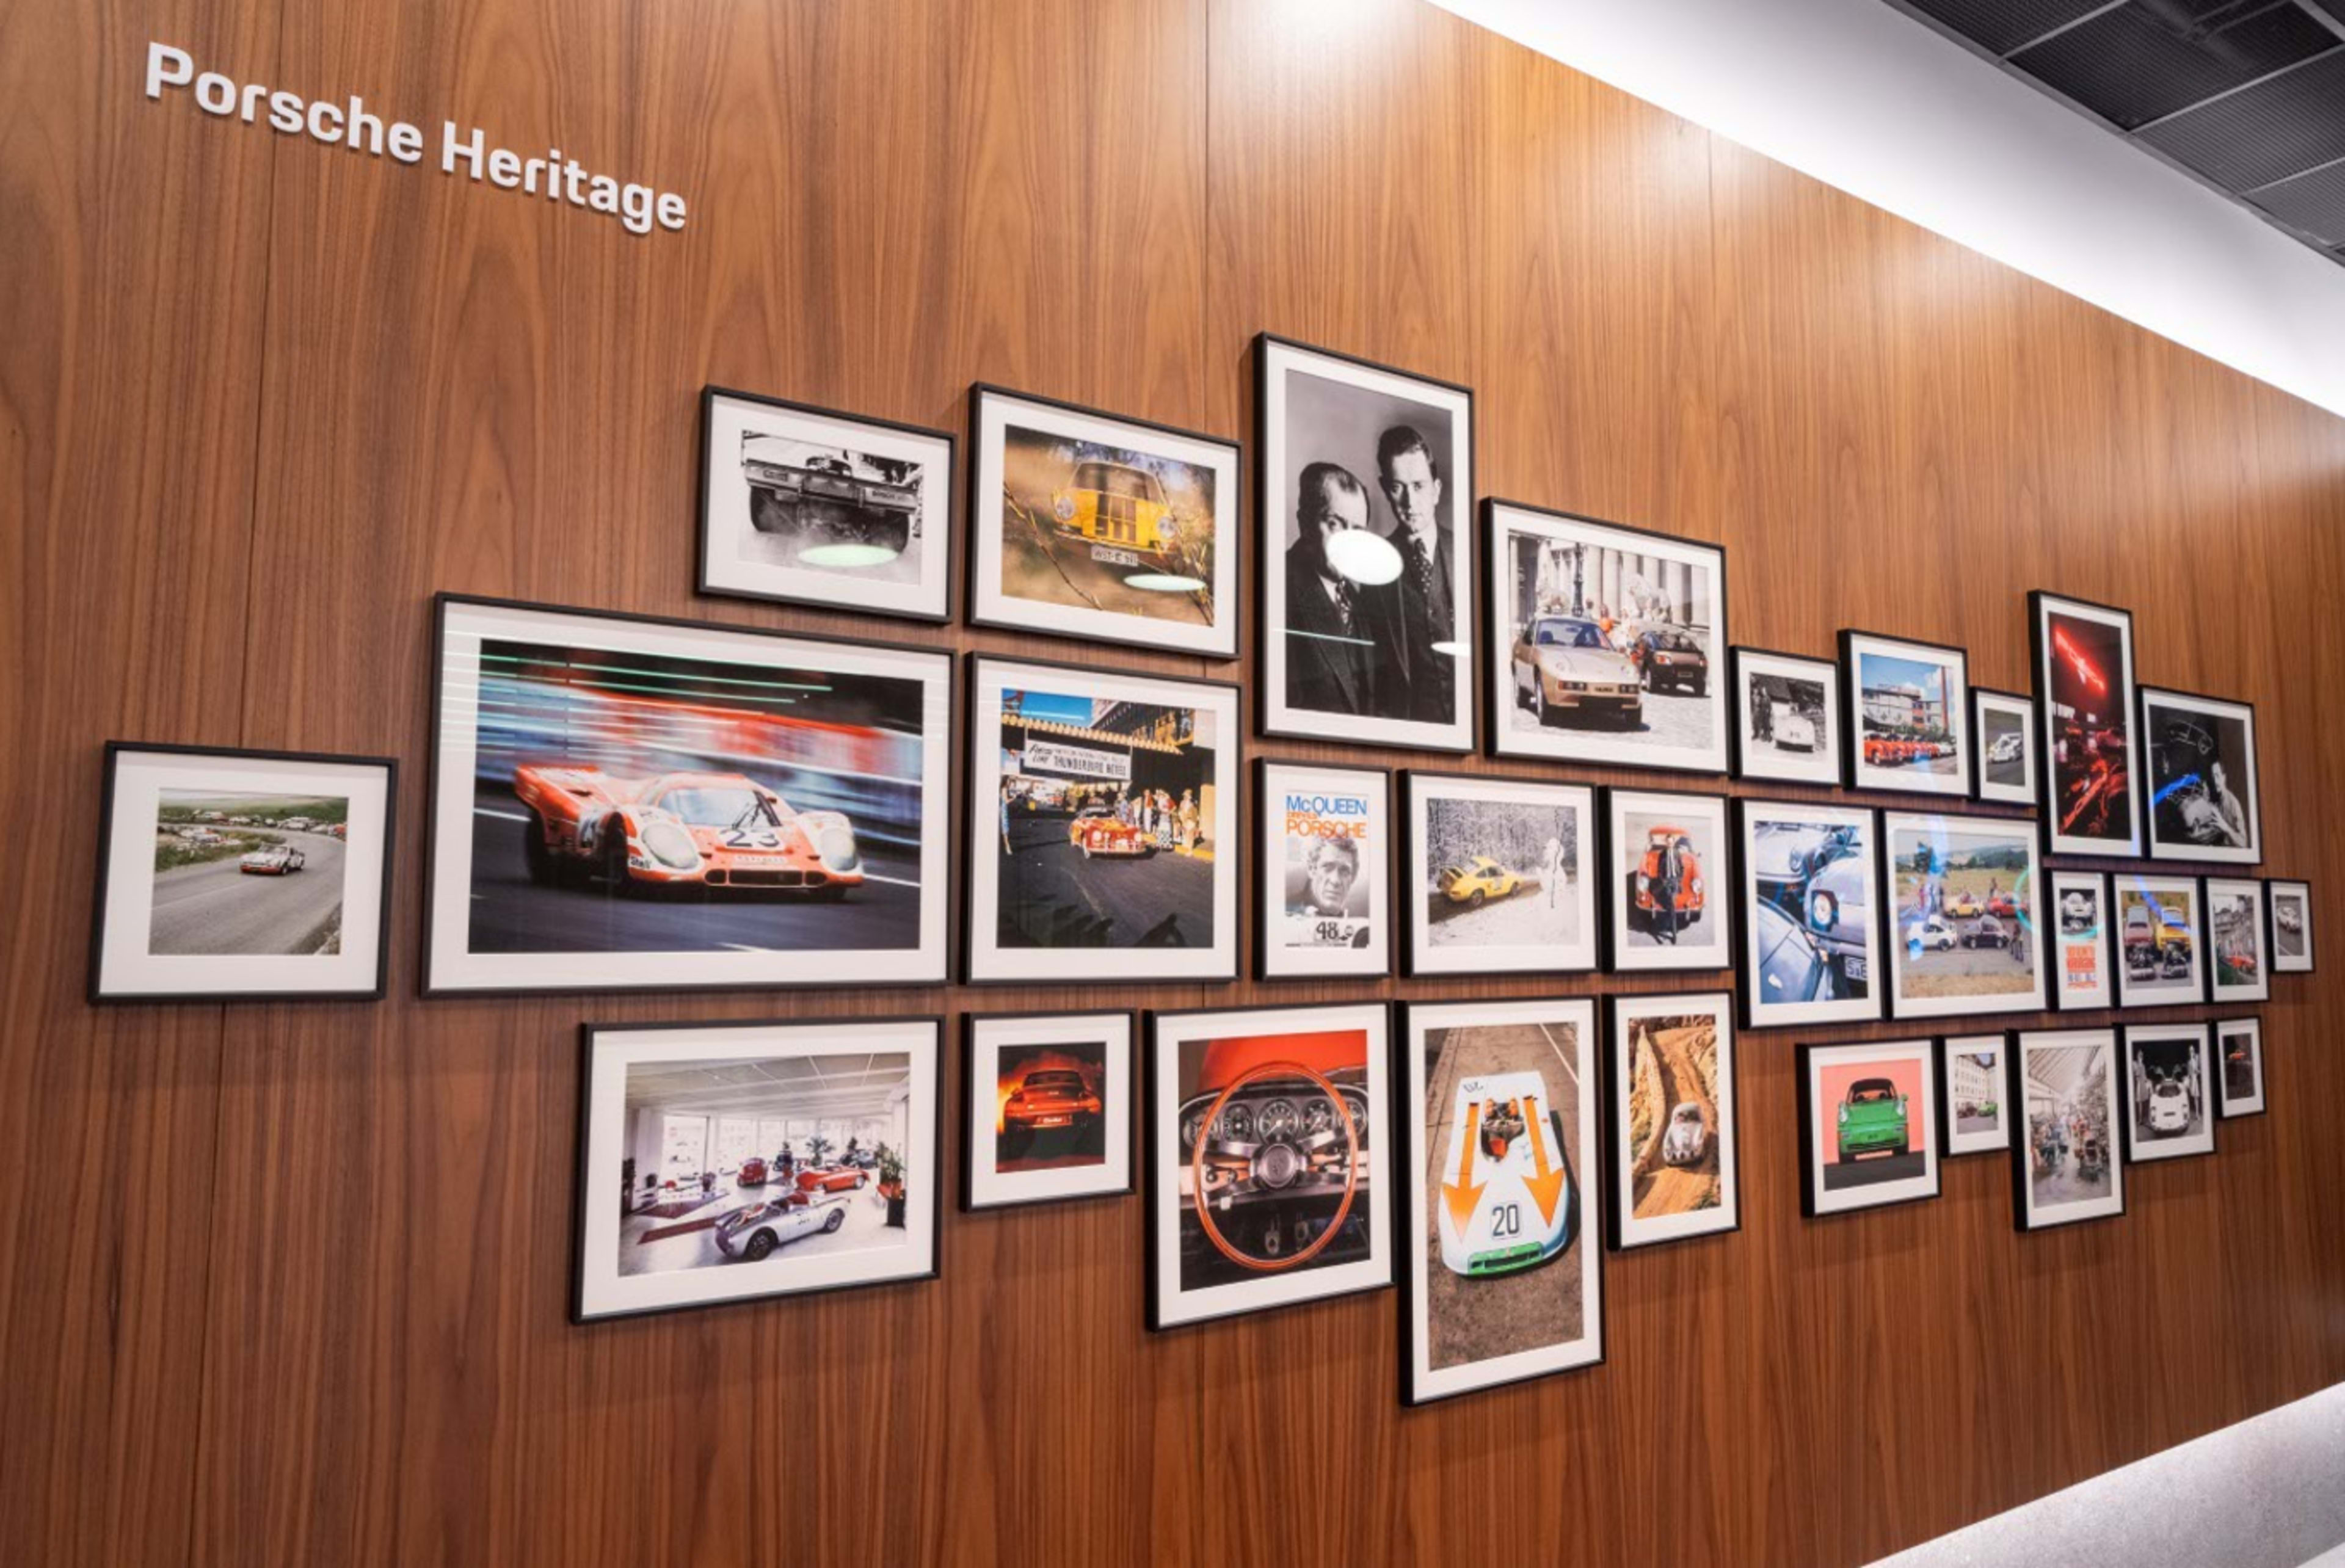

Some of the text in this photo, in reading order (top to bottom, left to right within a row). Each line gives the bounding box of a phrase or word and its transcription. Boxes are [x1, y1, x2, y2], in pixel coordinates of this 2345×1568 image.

[145, 42, 688, 234] Porsche Heritage
[1285, 795, 1367, 817] McQUEEN
[719, 829, 780, 848] 23
[1285, 819, 1367, 838] PORSCHE
[1315, 921, 1339, 940] 48
[1492, 1203, 1520, 1236] 20
